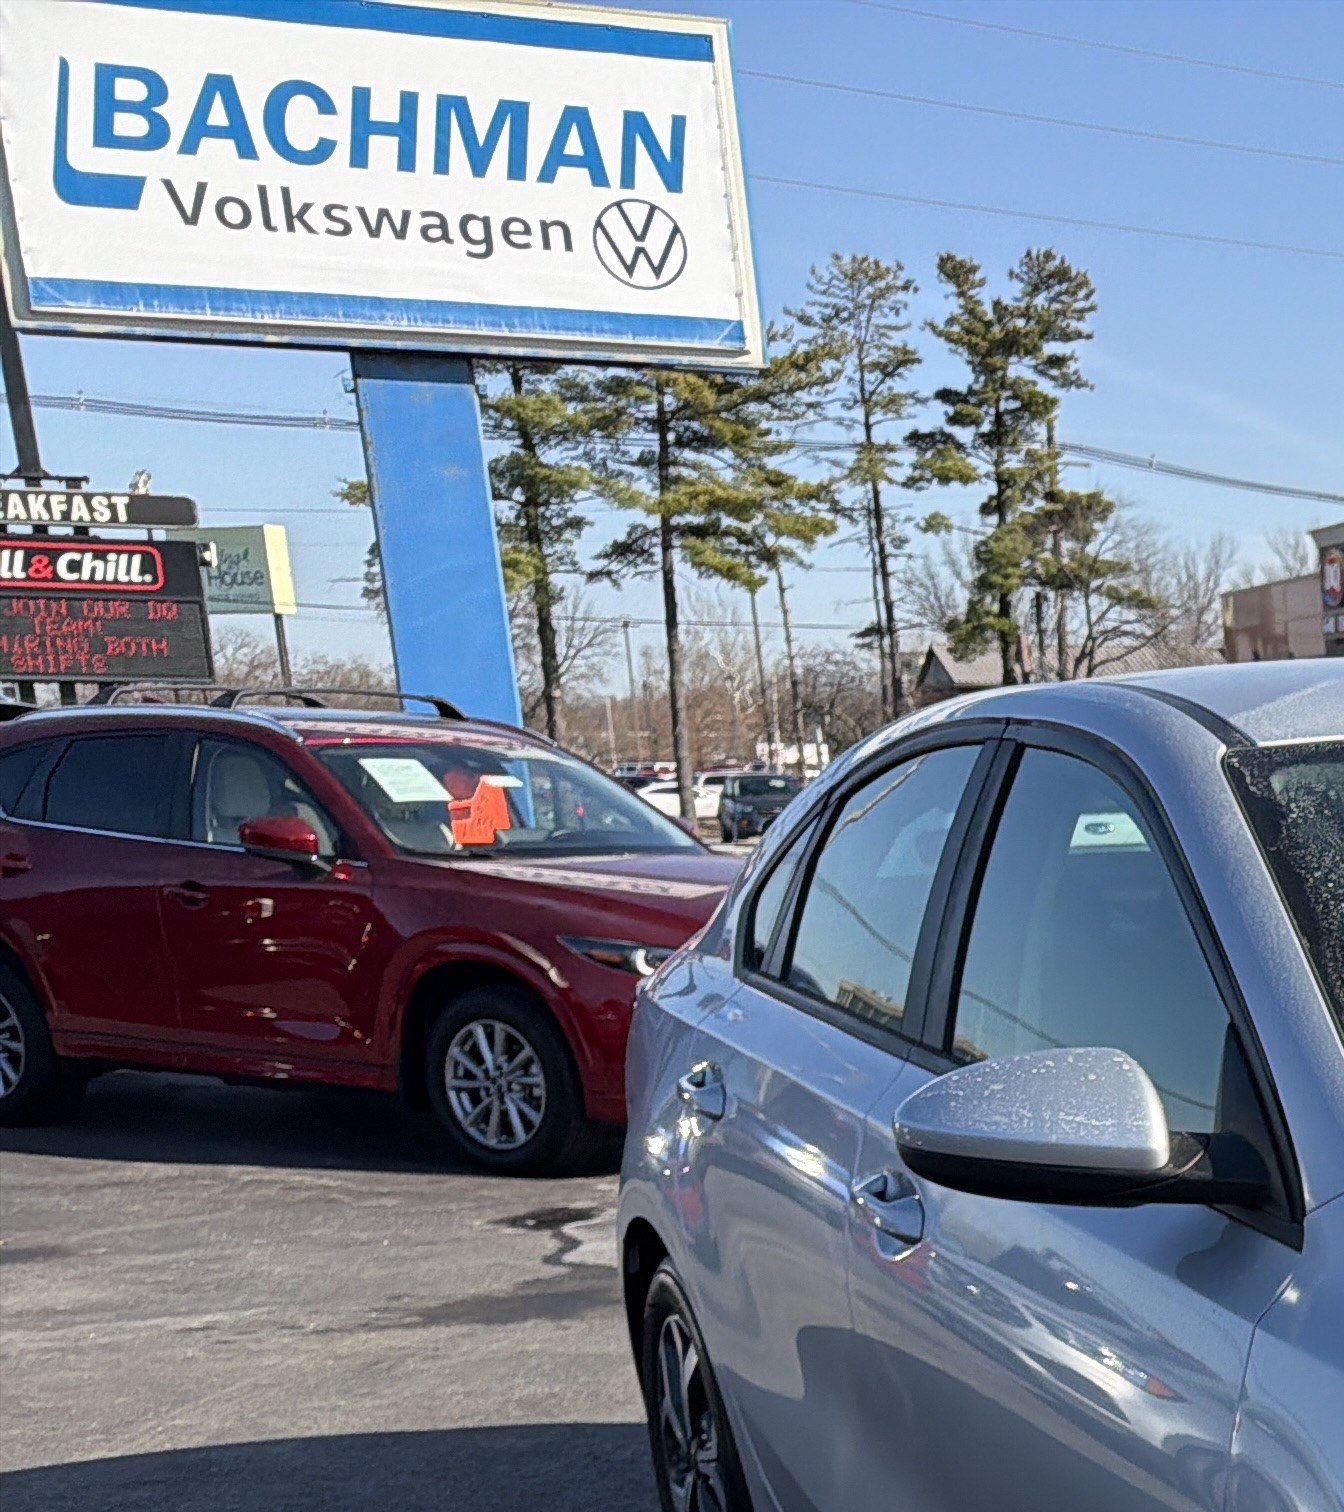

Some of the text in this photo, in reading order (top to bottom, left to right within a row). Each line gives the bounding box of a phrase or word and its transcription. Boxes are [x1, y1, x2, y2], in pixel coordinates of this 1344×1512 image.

[92, 61, 687, 193] BACHMAN
[160, 178, 575, 260] Volkswagen
[104, 635, 169, 657] BOTH
